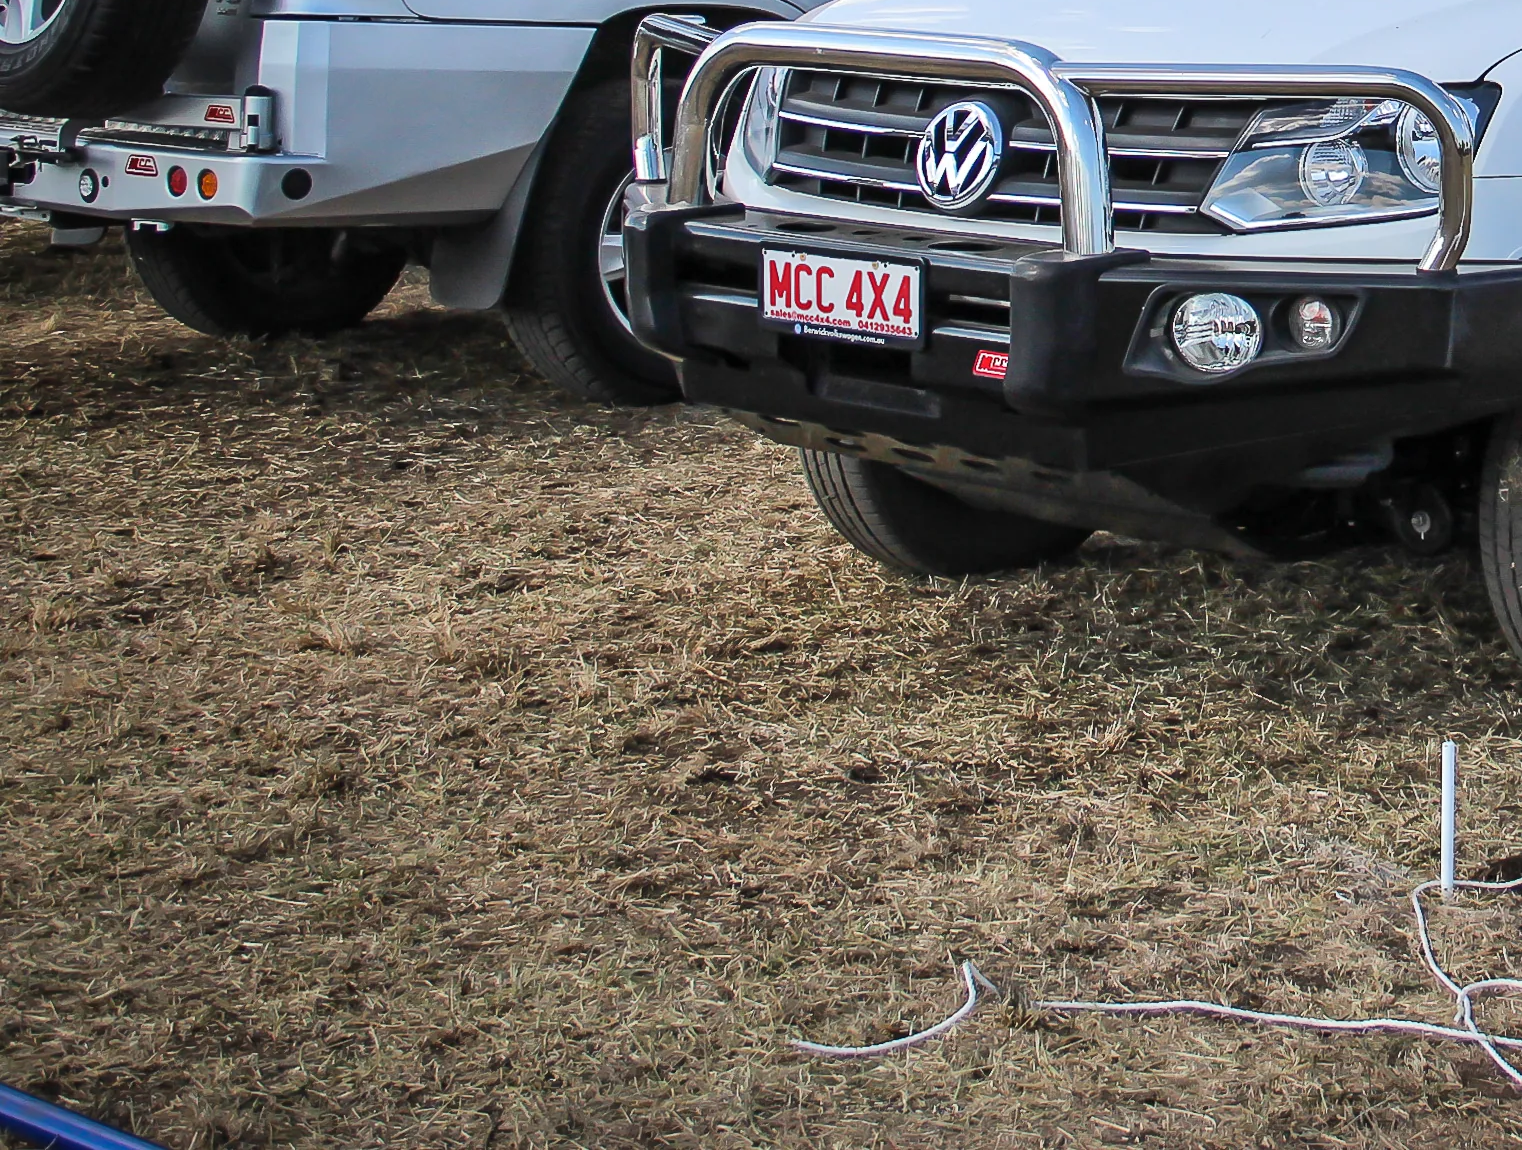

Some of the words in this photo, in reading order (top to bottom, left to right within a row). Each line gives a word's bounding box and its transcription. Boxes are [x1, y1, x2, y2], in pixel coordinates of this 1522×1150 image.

[769, 260, 835, 313] MCC
[846, 270, 912, 324] 4X4
[770, 309, 851, 327] sales@mcc4x4.com
[858, 320, 912, 336] 0412935643
